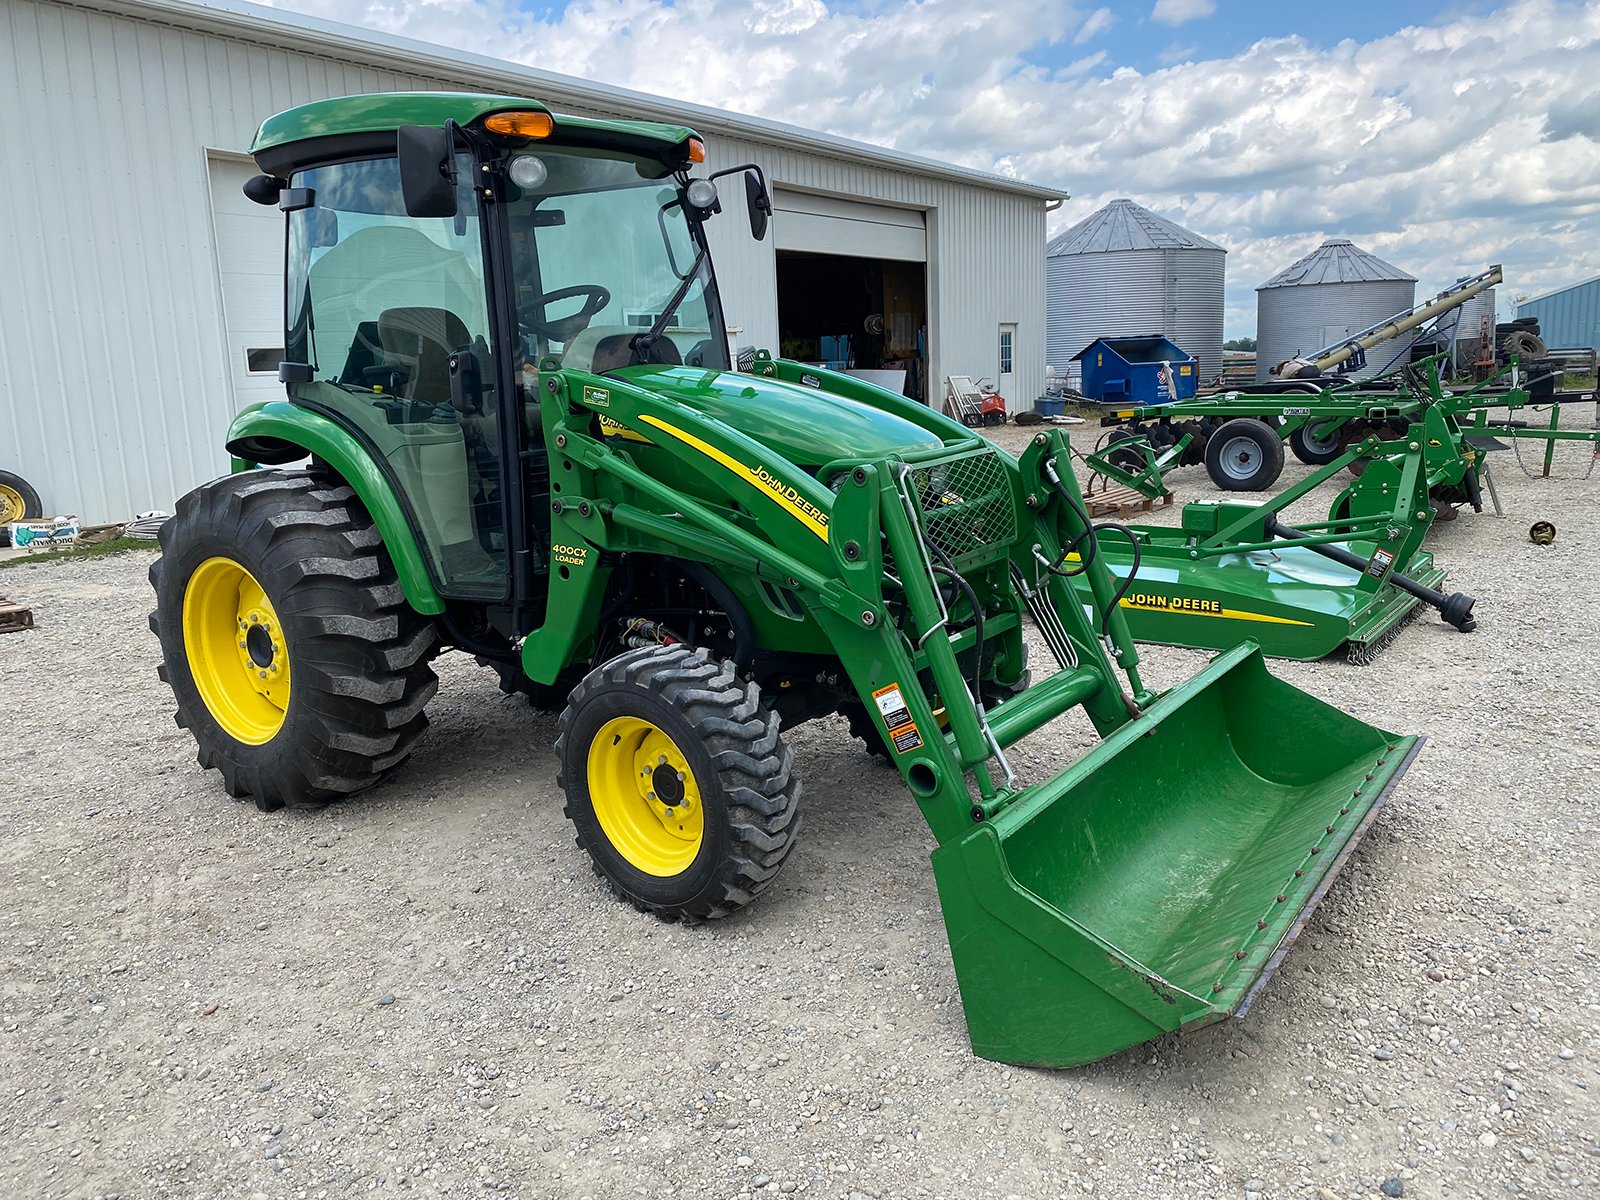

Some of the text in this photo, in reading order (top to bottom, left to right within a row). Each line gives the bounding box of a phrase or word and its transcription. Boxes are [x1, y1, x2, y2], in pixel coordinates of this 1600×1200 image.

[750, 465, 830, 525] JOHN DEERE
[552, 544, 588, 558] 400CX
[555, 554, 585, 566] LOADER
[1127, 593, 1220, 612] JOHN DEERE
